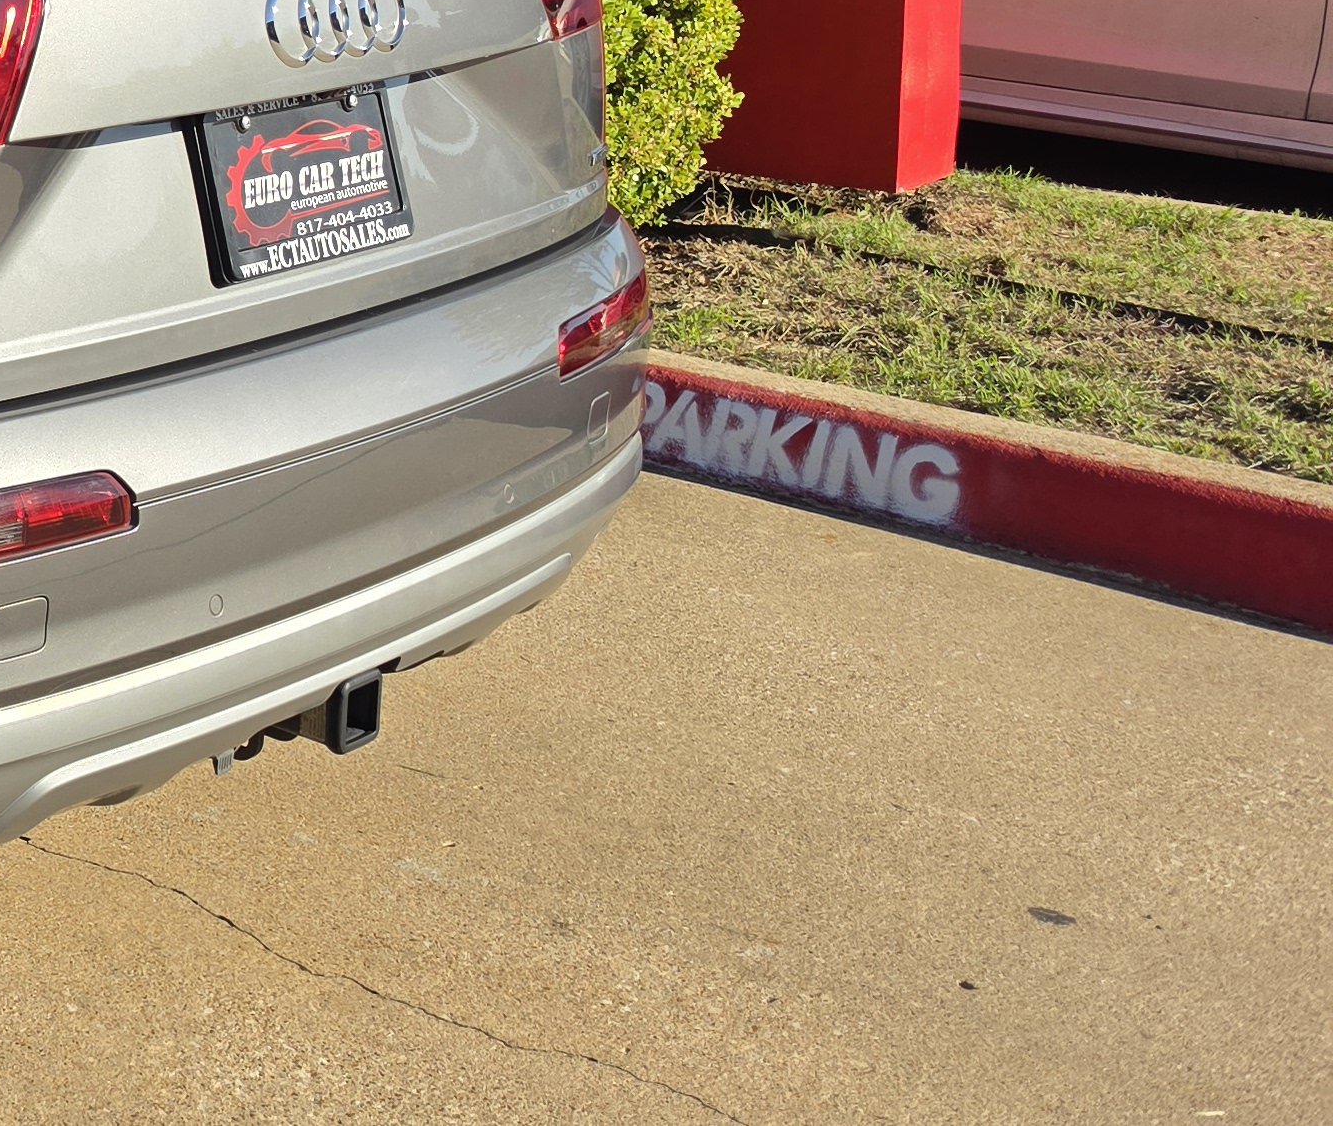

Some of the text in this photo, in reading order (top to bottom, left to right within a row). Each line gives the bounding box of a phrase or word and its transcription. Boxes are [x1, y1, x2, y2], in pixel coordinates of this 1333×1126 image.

[215, 105, 245, 121] SALES
[257, 96, 300, 112] SERVICE
[244, 150, 385, 209] EURO CAR TECH
[291, 179, 389, 210] european automotive
[296, 200, 393, 236] 817-404-4033
[239, 218, 410, 278] www.ECTAUTOSALES.com
